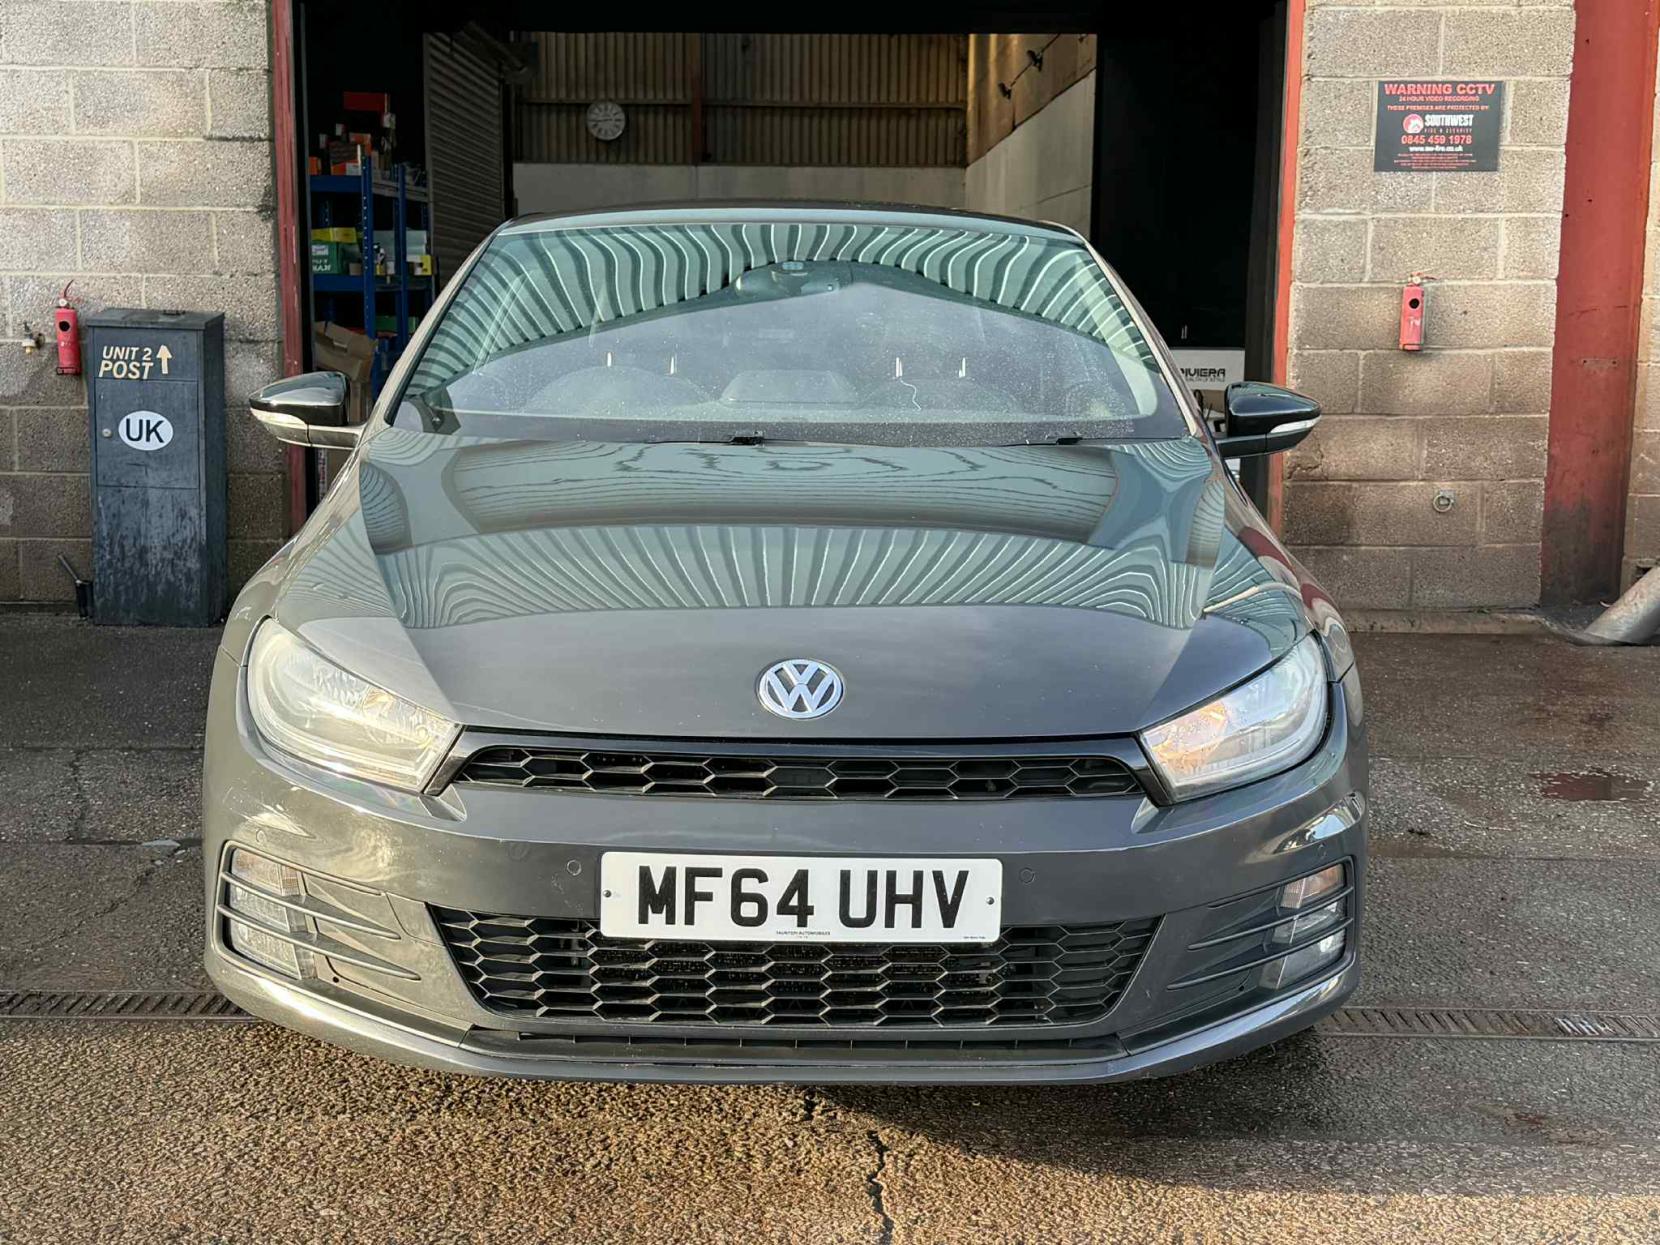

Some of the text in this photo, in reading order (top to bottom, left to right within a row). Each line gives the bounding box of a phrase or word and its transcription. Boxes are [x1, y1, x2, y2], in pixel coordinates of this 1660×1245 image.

[1384, 83, 1495, 95] WARNING CCTV
[1424, 114, 1474, 126] SOUTHWEST
[1401, 135, 1472, 144] 0845 459 1978
[102, 346, 152, 360] UNIT 2
[98, 360, 154, 380] POST
[1180, 367, 1226, 377] IVIERA
[125, 418, 165, 443] UK
[638, 865, 970, 929] MF64 UHV
